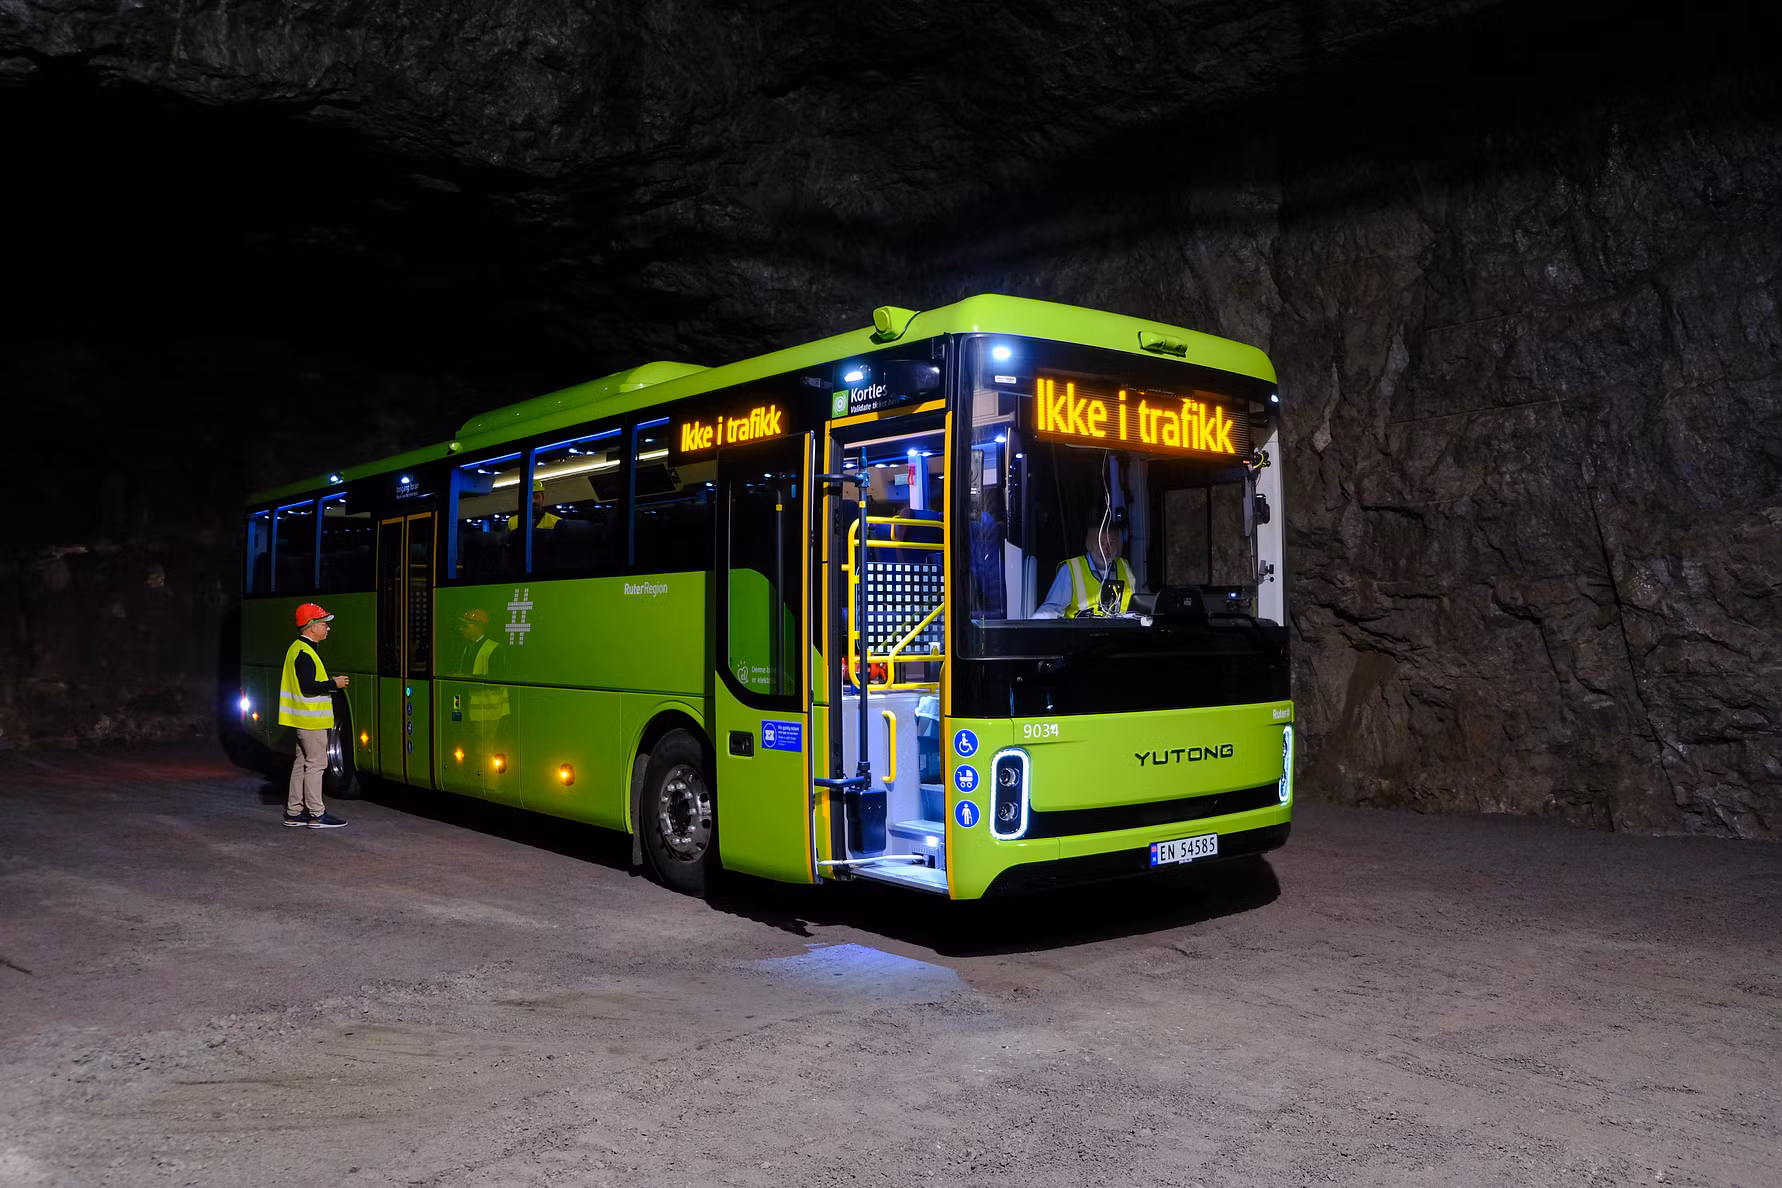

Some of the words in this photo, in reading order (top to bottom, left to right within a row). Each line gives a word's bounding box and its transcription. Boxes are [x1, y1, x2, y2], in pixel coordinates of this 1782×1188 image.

[1037, 378, 1107, 437] Ikke
[1119, 390, 1127, 440] i
[1138, 397, 1235, 454] trafikk
[681, 421, 713, 452] Ikke
[717, 416, 723, 445] i
[727, 404, 782, 443] trafikk
[624, 581, 668, 598] RuterRegion
[1023, 723, 1059, 739] 9034
[1134, 744, 1233, 766] YUTONG
[1160, 844, 1175, 861] EN
[1180, 837, 1215, 858] 54585
